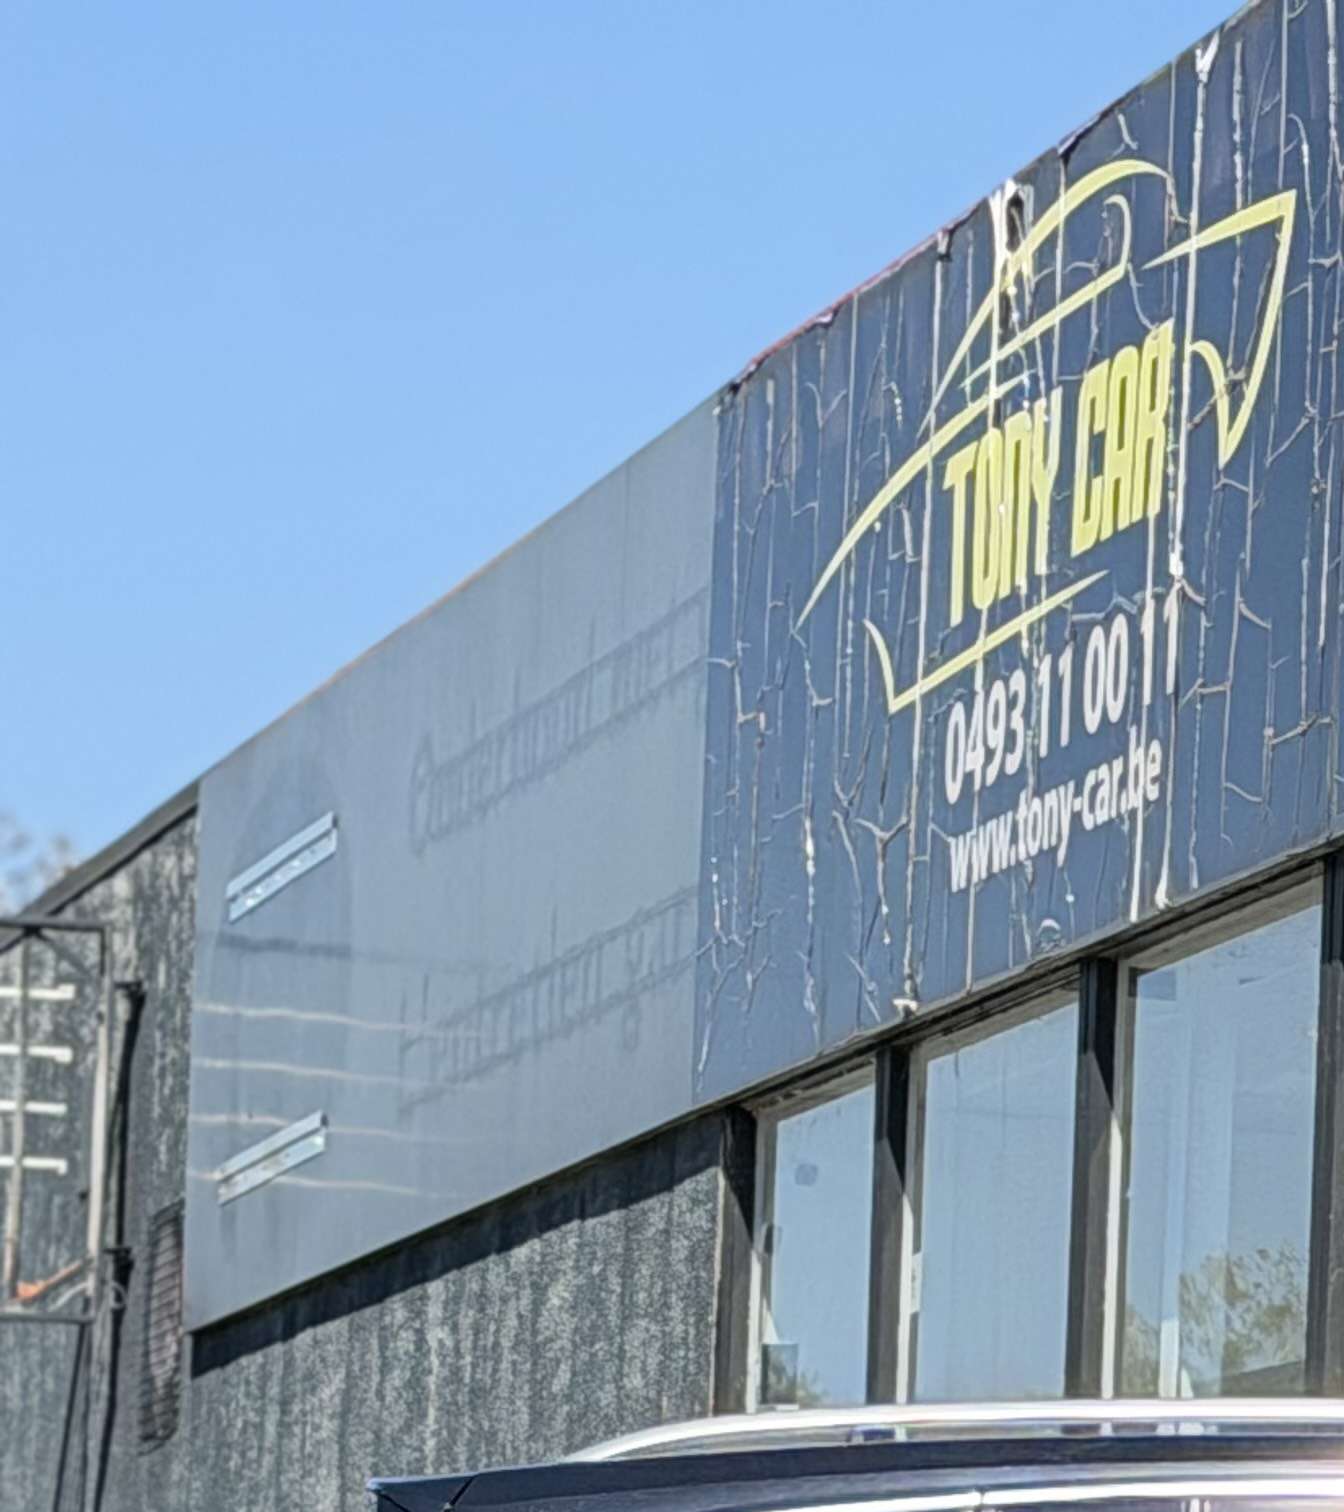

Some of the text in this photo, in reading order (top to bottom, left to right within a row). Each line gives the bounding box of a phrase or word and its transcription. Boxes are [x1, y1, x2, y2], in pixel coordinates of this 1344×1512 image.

[942, 316, 1176, 628] TONY CAR
[945, 582, 1180, 805] 0493 11 00 11
[947, 723, 1163, 894] www.tony-car.be
